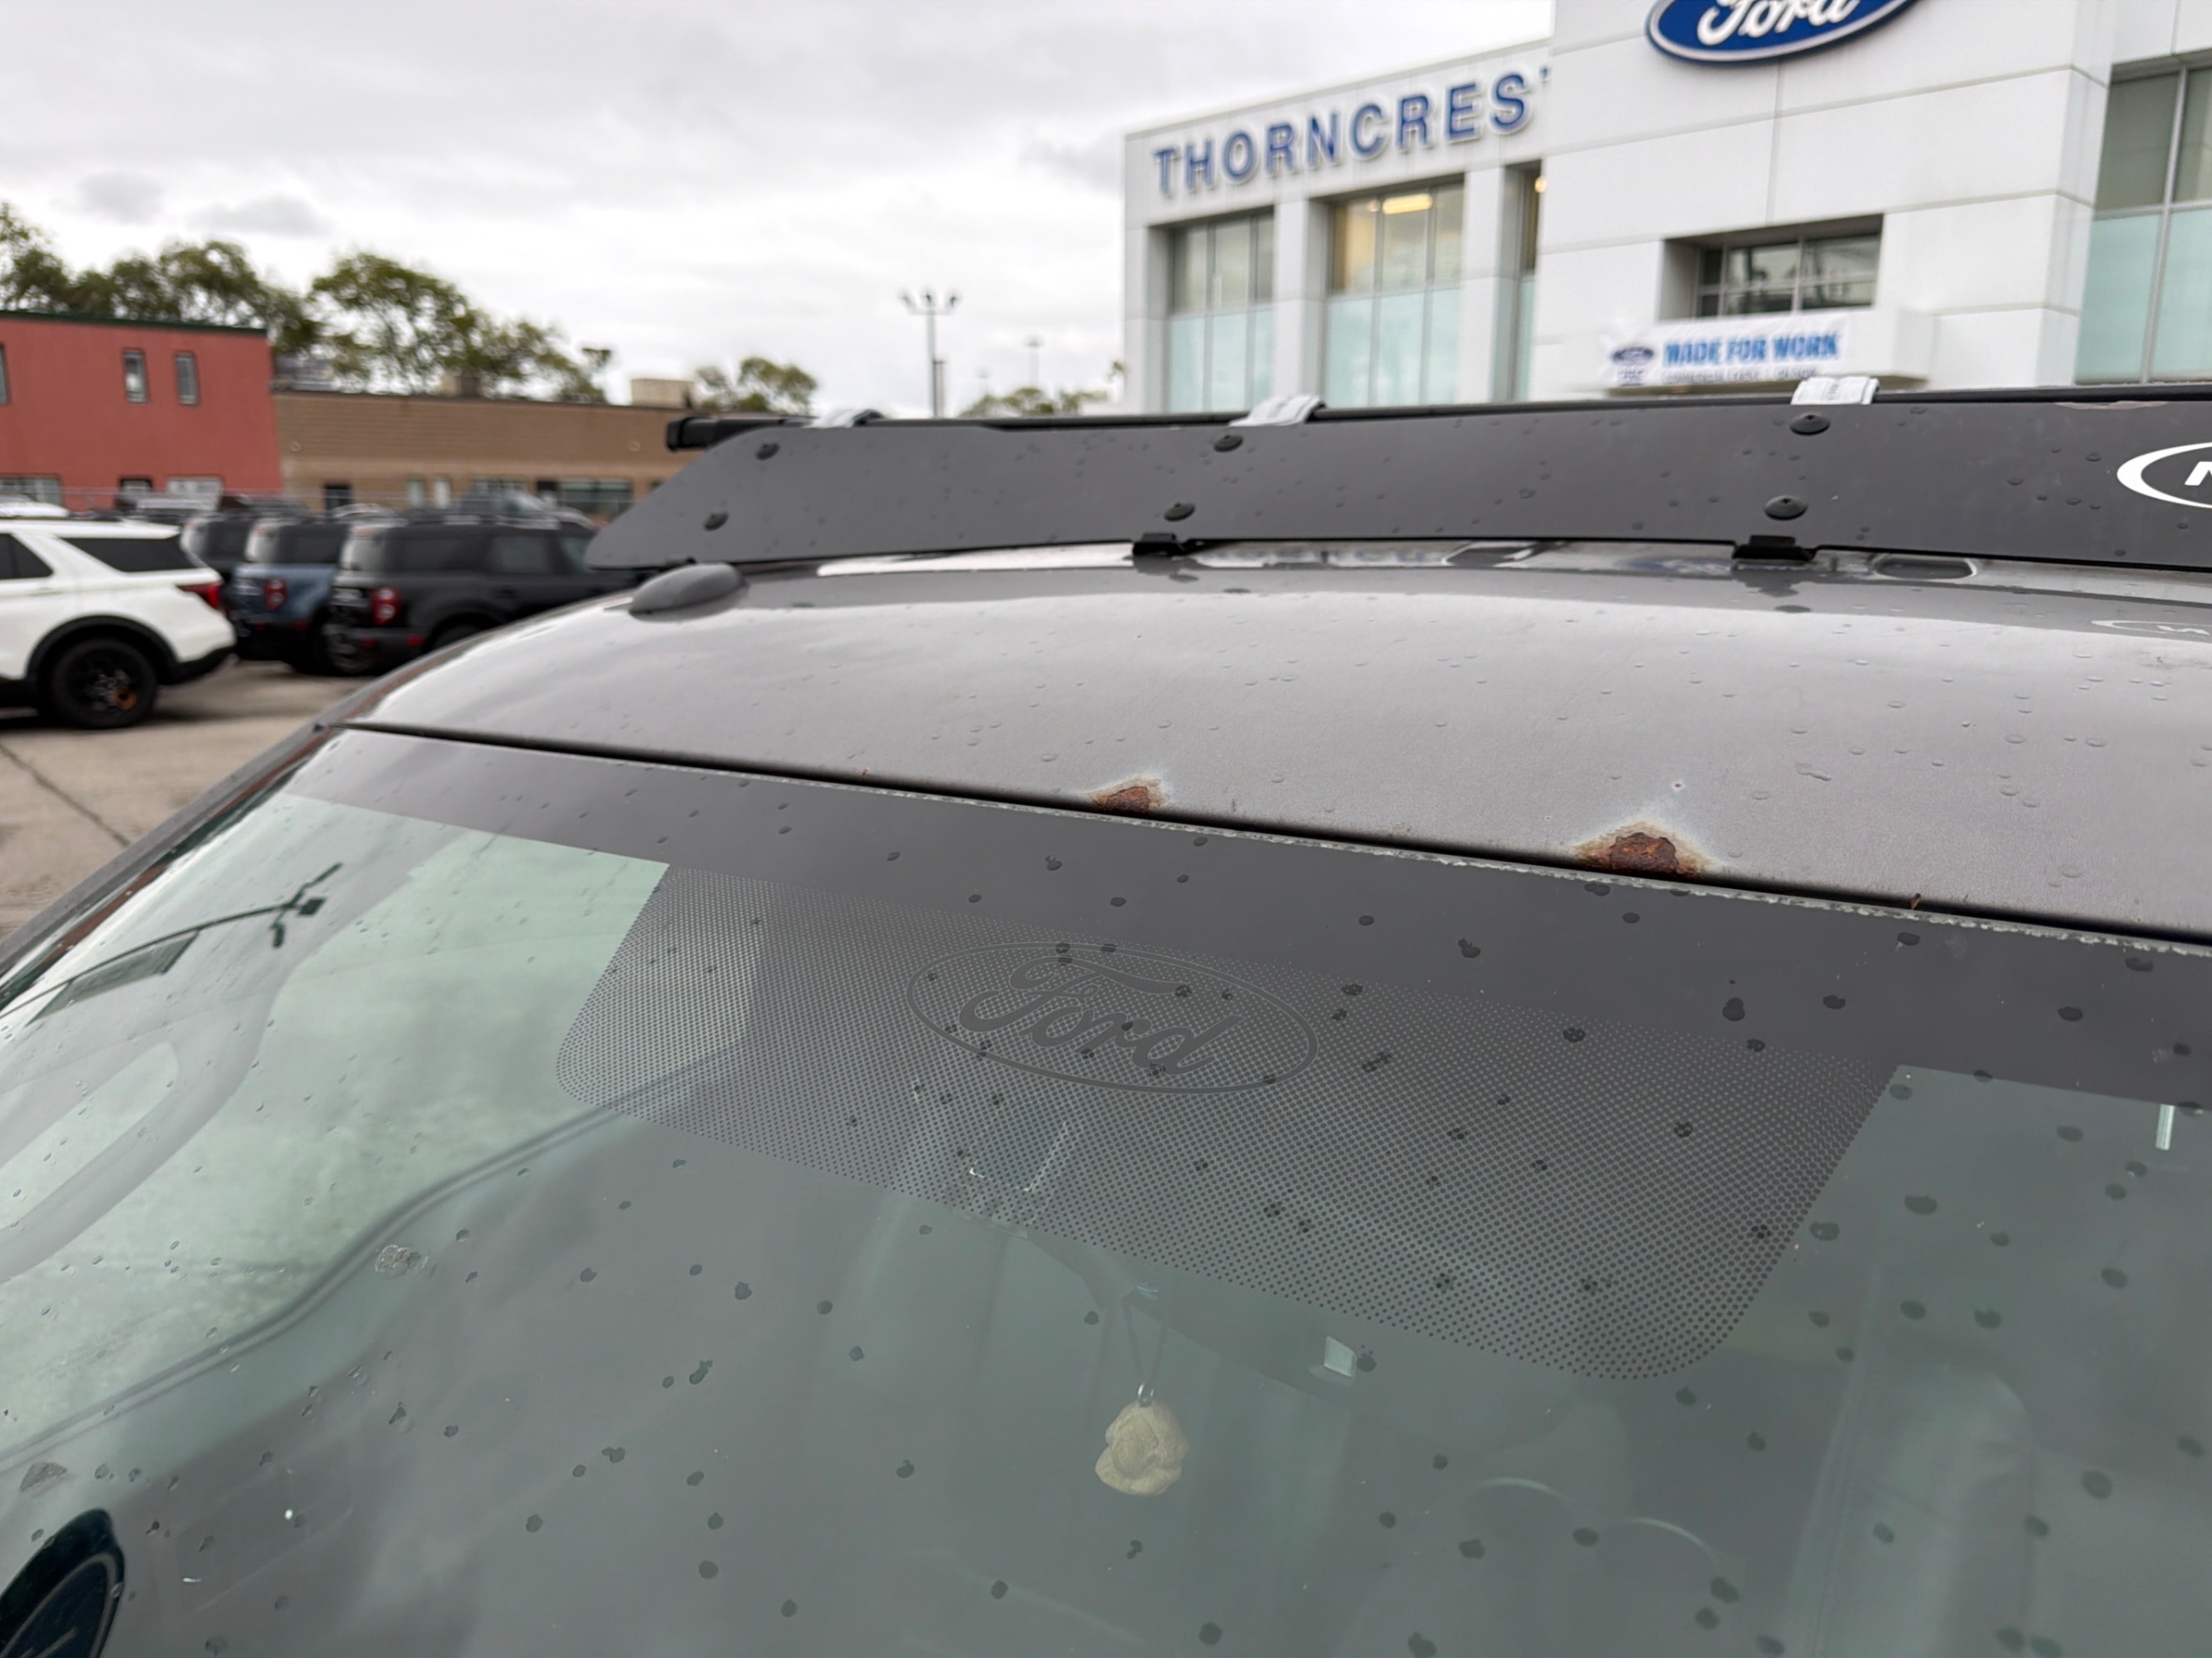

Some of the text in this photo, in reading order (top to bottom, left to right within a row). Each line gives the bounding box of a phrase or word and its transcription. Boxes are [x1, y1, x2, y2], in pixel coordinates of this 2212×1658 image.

[1152, 67, 1552, 196] THORNCRES
[1664, 341, 1721, 366] MADE
[1725, 337, 1767, 361] FOR
[1772, 332, 1837, 359] WORK
[958, 956, 1244, 1076] Ford
